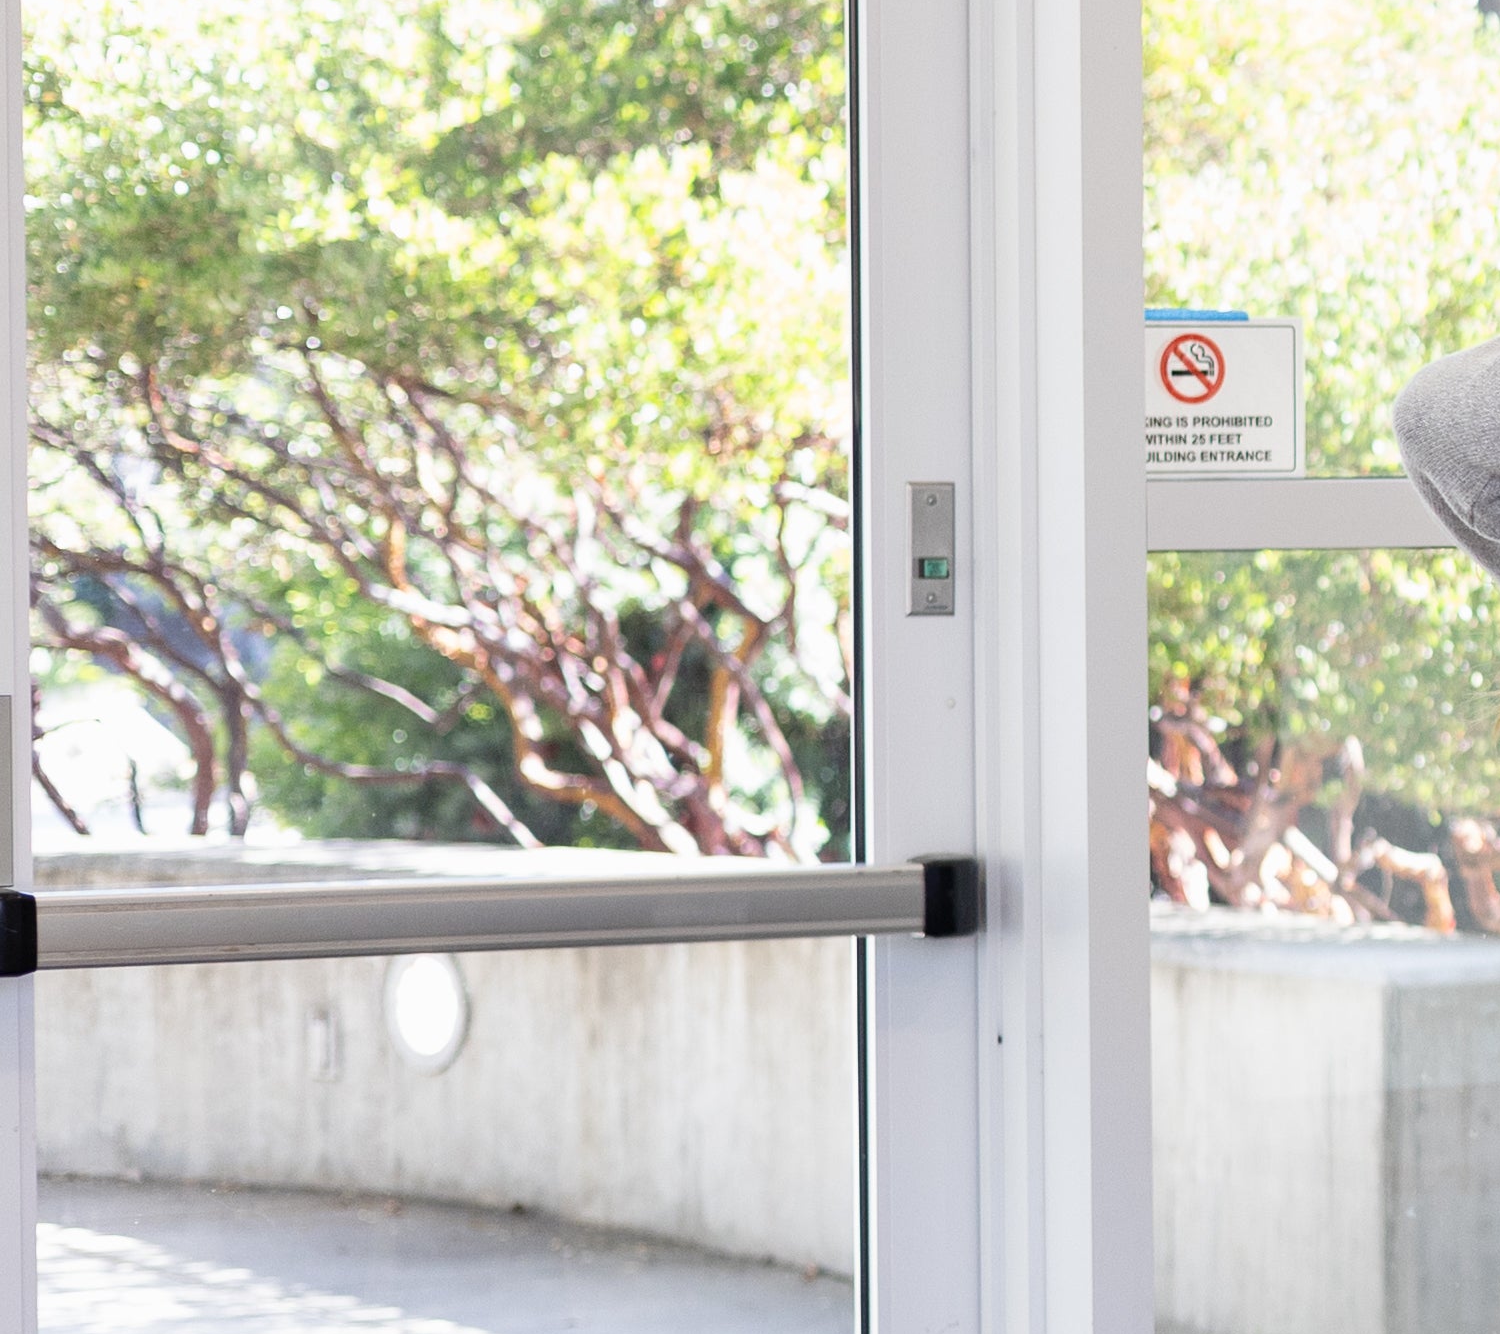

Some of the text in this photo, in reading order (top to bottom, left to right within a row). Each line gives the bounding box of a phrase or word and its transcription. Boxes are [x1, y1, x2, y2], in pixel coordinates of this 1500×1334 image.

[1176, 415, 1188, 428] IS
[1192, 415, 1274, 428] PROHIBITED
[1192, 432, 1206, 445] 25
[1209, 432, 1243, 445] FEET
[1146, 449, 1273, 464] UILDING ENTRANCE
